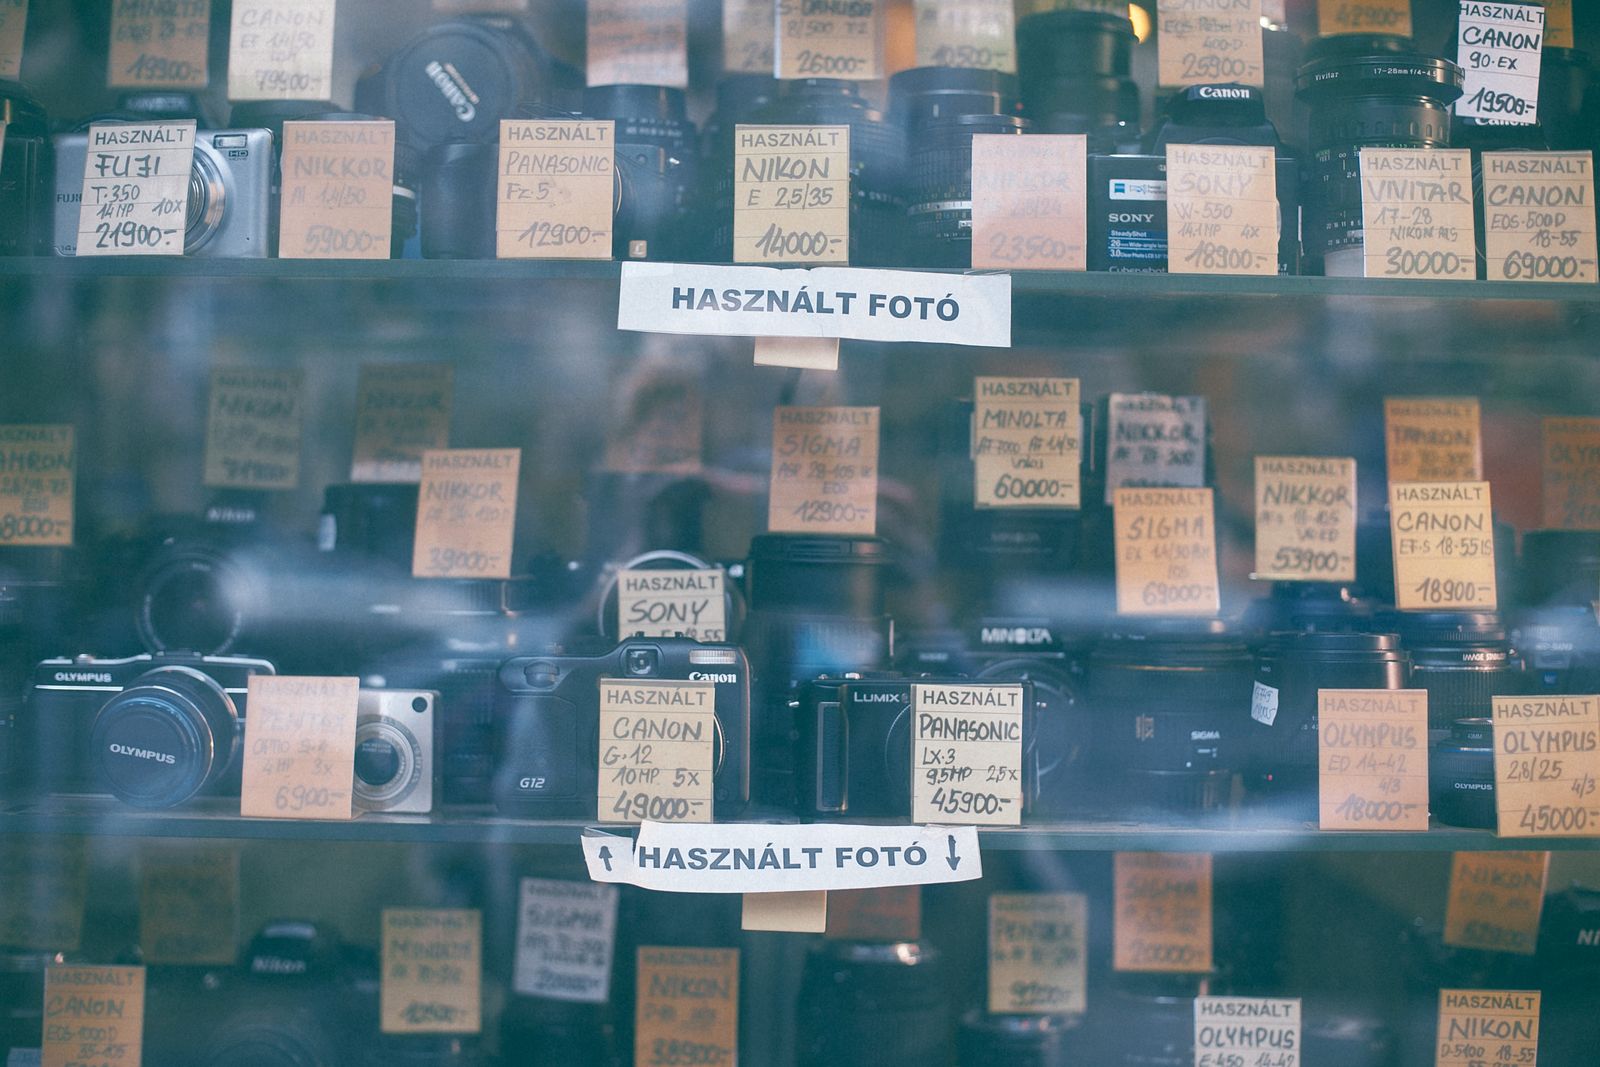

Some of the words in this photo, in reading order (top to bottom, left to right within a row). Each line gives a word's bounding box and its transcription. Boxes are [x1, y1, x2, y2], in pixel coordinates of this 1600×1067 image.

[240, 9, 325, 26] CANON
[1459, 3, 1544, 23] HASZNÁLT
[1462, 26, 1541, 51] CANON
[425, 61, 476, 122] Canon
[1199, 86, 1250, 99] Canon
[94, 127, 188, 145] HASZNÁLT
[293, 128, 392, 145] HASZNÁLT
[507, 125, 608, 142] HASZNÁLT
[741, 128, 840, 147] HASZNÁLT
[95, 153, 161, 177] FUJI
[294, 155, 388, 181] NIKKOR
[505, 151, 610, 175] PANASONIC
[742, 156, 830, 182] NIKON
[1173, 149, 1269, 169] HASZNÁLT
[1366, 154, 1462, 172] HASZNÁLT
[1491, 154, 1587, 174] HASZNÁLT
[1173, 172, 1254, 195] SONY
[747, 188, 762, 207] E
[1488, 185, 1585, 206] CANON
[1108, 213, 1155, 223] SONY
[1373, 206, 1433, 225] 17-28
[1110, 230, 1147, 238] SteadyShot
[1389, 225, 1434, 241] NIKON
[1529, 230, 1582, 246] 18-55
[671, 285, 857, 315] HASZNÁLT
[868, 292, 960, 322] FOTÓ
[982, 379, 1074, 398] HASZNÁLT
[780, 410, 871, 425] HASZNÁLT
[982, 407, 1067, 430] MINOLTA
[1115, 421, 1200, 445] NIKKOR
[779, 433, 862, 456] SIGMA
[429, 454, 514, 469] HASZNÁLT
[425, 480, 505, 502] NIKKOR
[1263, 480, 1352, 509] NIKKOR
[1395, 486, 1483, 501] HASZNÁLT
[1127, 515, 1204, 541] SIGMA
[1396, 511, 1484, 532] CANON
[626, 572, 718, 591] HASZNÁLT
[627, 598, 710, 626] SONY
[981, 627, 1053, 644] MINOLTA
[54, 672, 112, 683] OLYMPUS
[688, 671, 737, 683] Canon
[606, 686, 708, 706] HASZNÁLT
[853, 691, 899, 703] LUMIX
[922, 688, 1019, 708] HASZNÁLT
[1323, 694, 1419, 713] HASZNÁLT
[1497, 698, 1592, 720] HASZNÁLT
[612, 716, 703, 741] CANON
[919, 712, 1021, 742] PANASONIC
[1190, 730, 1220, 741] SIGMA
[1323, 722, 1418, 750] OLYMPUS
[1503, 730, 1597, 755] OLYMPUS
[109, 743, 176, 764] OLYMPUS
[1327, 755, 1350, 772] ED
[519, 777, 546, 789] G12
[1454, 783, 1493, 791] OLYMPUS
[1571, 773, 1597, 799] 4/3
[638, 841, 824, 871] HASZNÁLT
[835, 840, 928, 869] FOTÓ
[648, 973, 730, 1000] NIKON
[47, 993, 126, 1018] CANON
[1201, 1000, 1292, 1018] HASZNÁLT
[1445, 993, 1536, 1010] HASZNÁLT
[1199, 1025, 1295, 1050] OLYMPUS
[1447, 1017, 1533, 1042] NIKON
